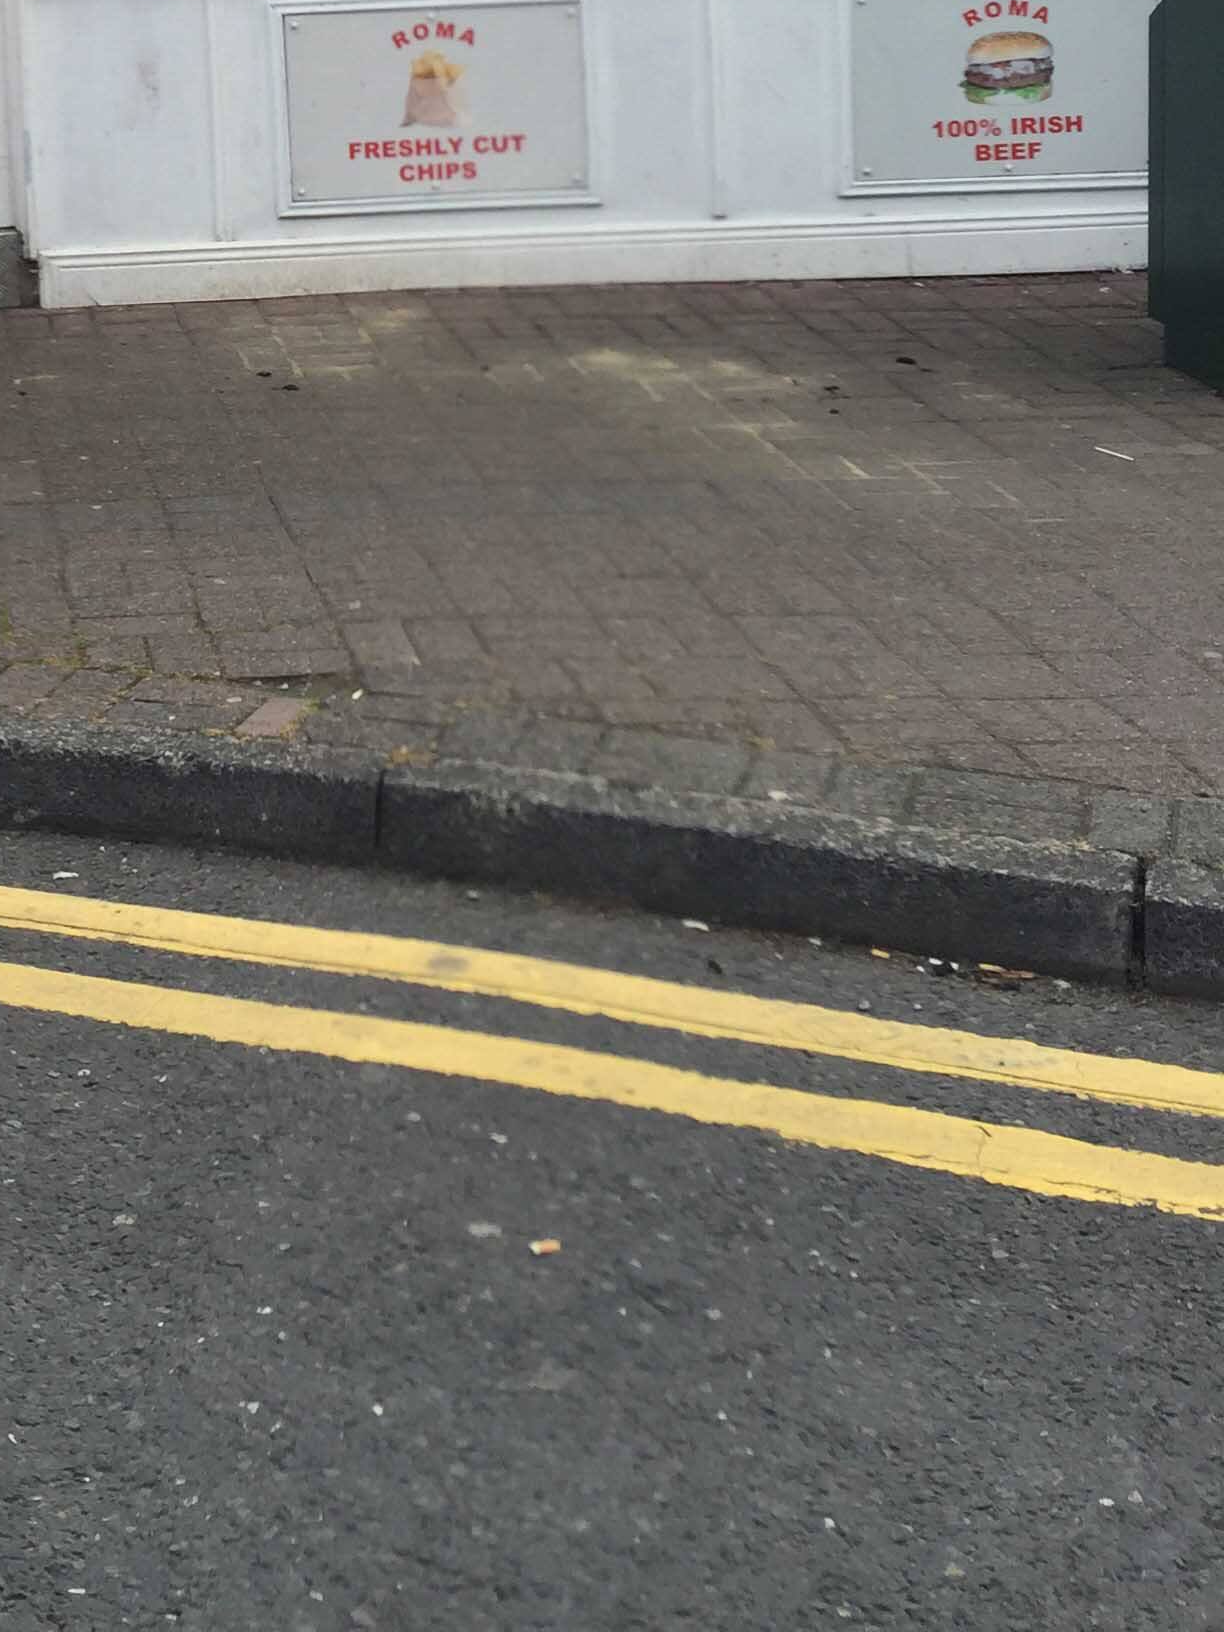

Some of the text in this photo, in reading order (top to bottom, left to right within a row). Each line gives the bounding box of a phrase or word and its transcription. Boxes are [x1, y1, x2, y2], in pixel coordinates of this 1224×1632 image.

[961, 0, 1049, 28] ROMA
[391, 21, 475, 49] ROMA
[933, 114, 1084, 138] 100% IRISH
[348, 134, 527, 160] FRESHLY CUT
[975, 142, 1043, 161] BEEF
[399, 161, 478, 182] CHIPS
